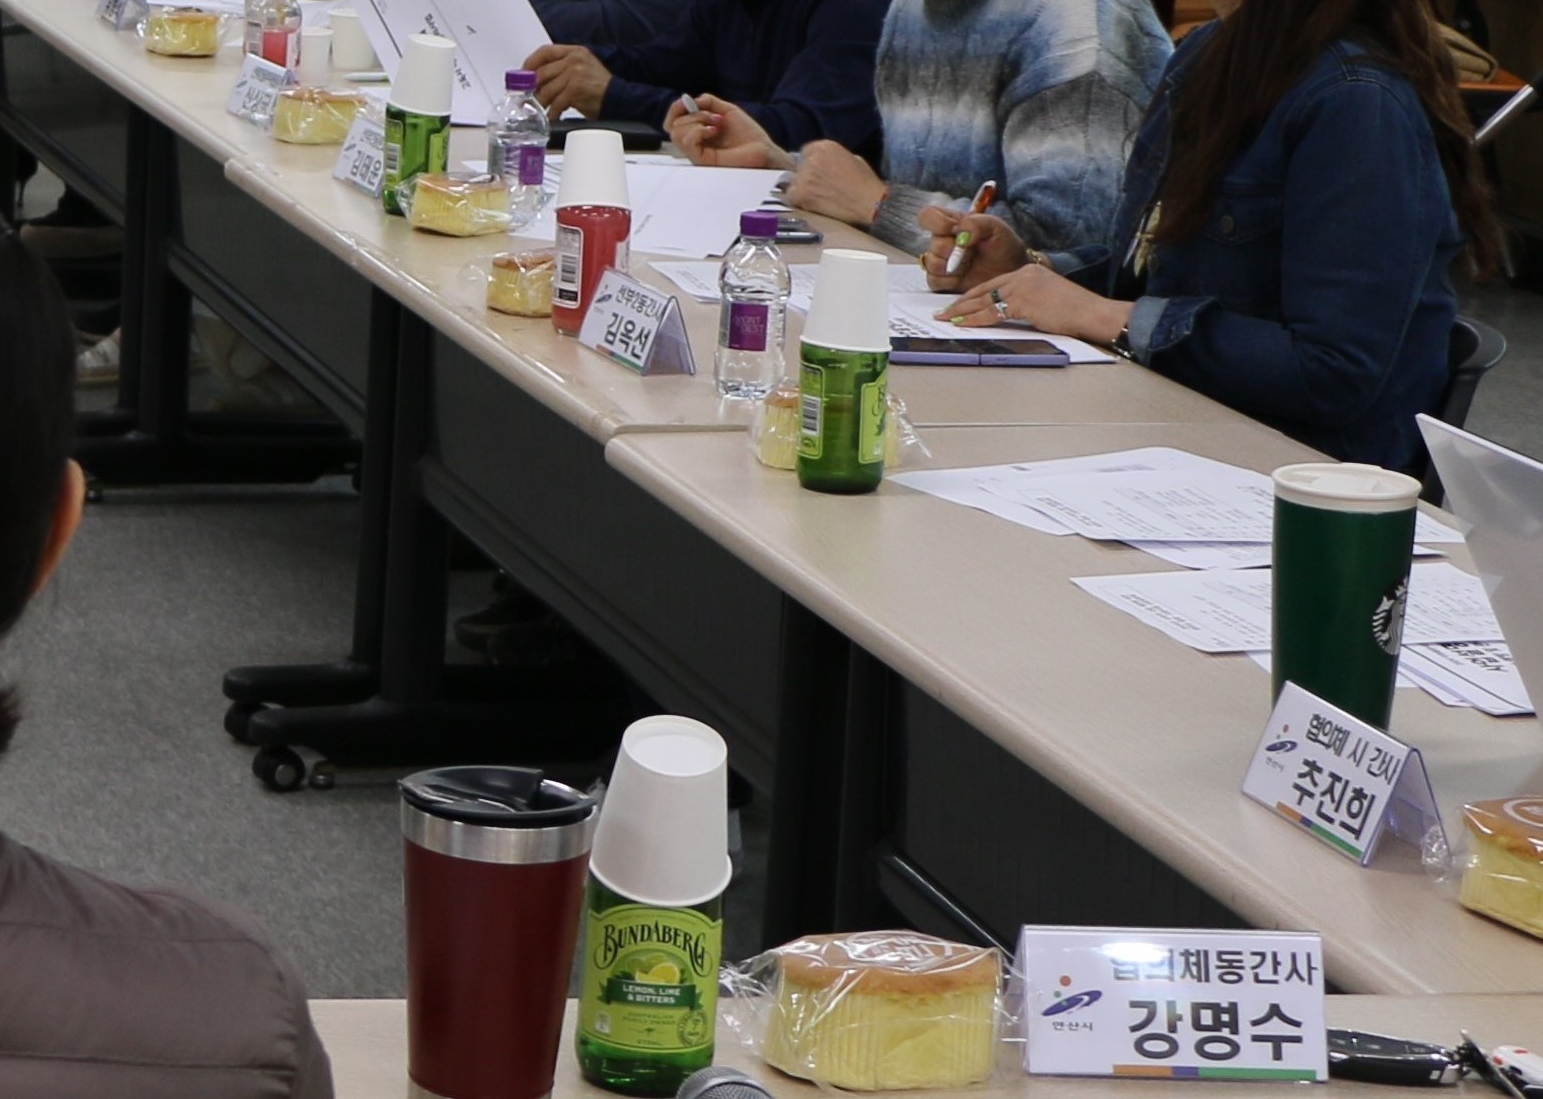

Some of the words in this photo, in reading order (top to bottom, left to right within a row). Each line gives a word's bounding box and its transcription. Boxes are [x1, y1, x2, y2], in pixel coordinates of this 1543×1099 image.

[603, 311, 652, 361] 김옥선
[1305, 712, 1352, 758] 협의체
[1348, 736, 1370, 768] 시
[1366, 745, 1402, 787] 간사
[1291, 757, 1377, 841] 추진희
[593, 919, 713, 979] BUNDABERG
[635, 994, 676, 1004] BITTERS
[658, 984, 682, 997] LIME
[1128, 999, 1304, 1062] 강명수
